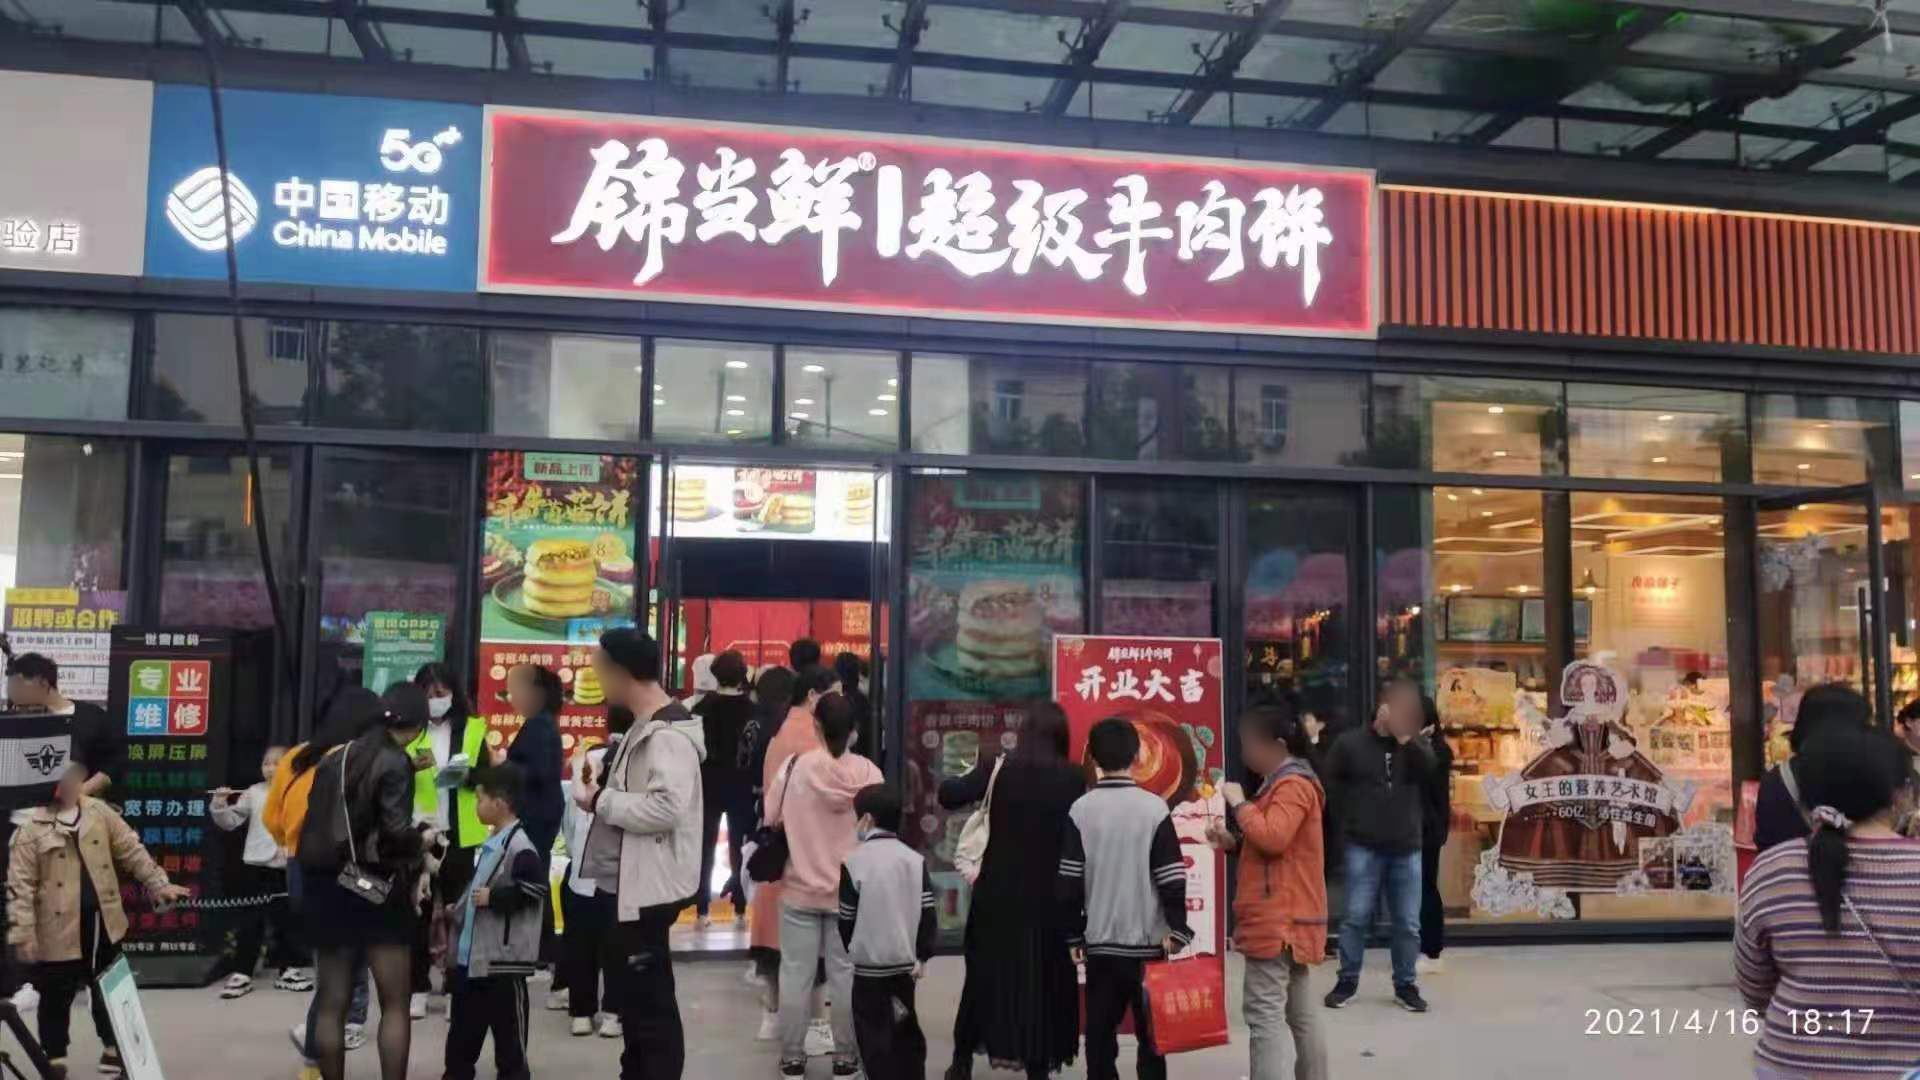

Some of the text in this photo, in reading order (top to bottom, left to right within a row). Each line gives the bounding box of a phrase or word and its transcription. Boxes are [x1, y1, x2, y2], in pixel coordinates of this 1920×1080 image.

[273, 176, 449, 226] 中国移动
[551, 138, 1334, 308] 锦当鲜 超级牛肉饼
[273, 222, 447, 255] China Mobile
[12, 608, 120, 629] 招聘或合作
[137, 666, 203, 692] 专业
[1075, 665, 1204, 703] 开业大吉
[135, 703, 202, 730] 维修
[1524, 779, 1658, 803] 女王的营养艺术馆
[124, 799, 205, 818] 宽带办理
